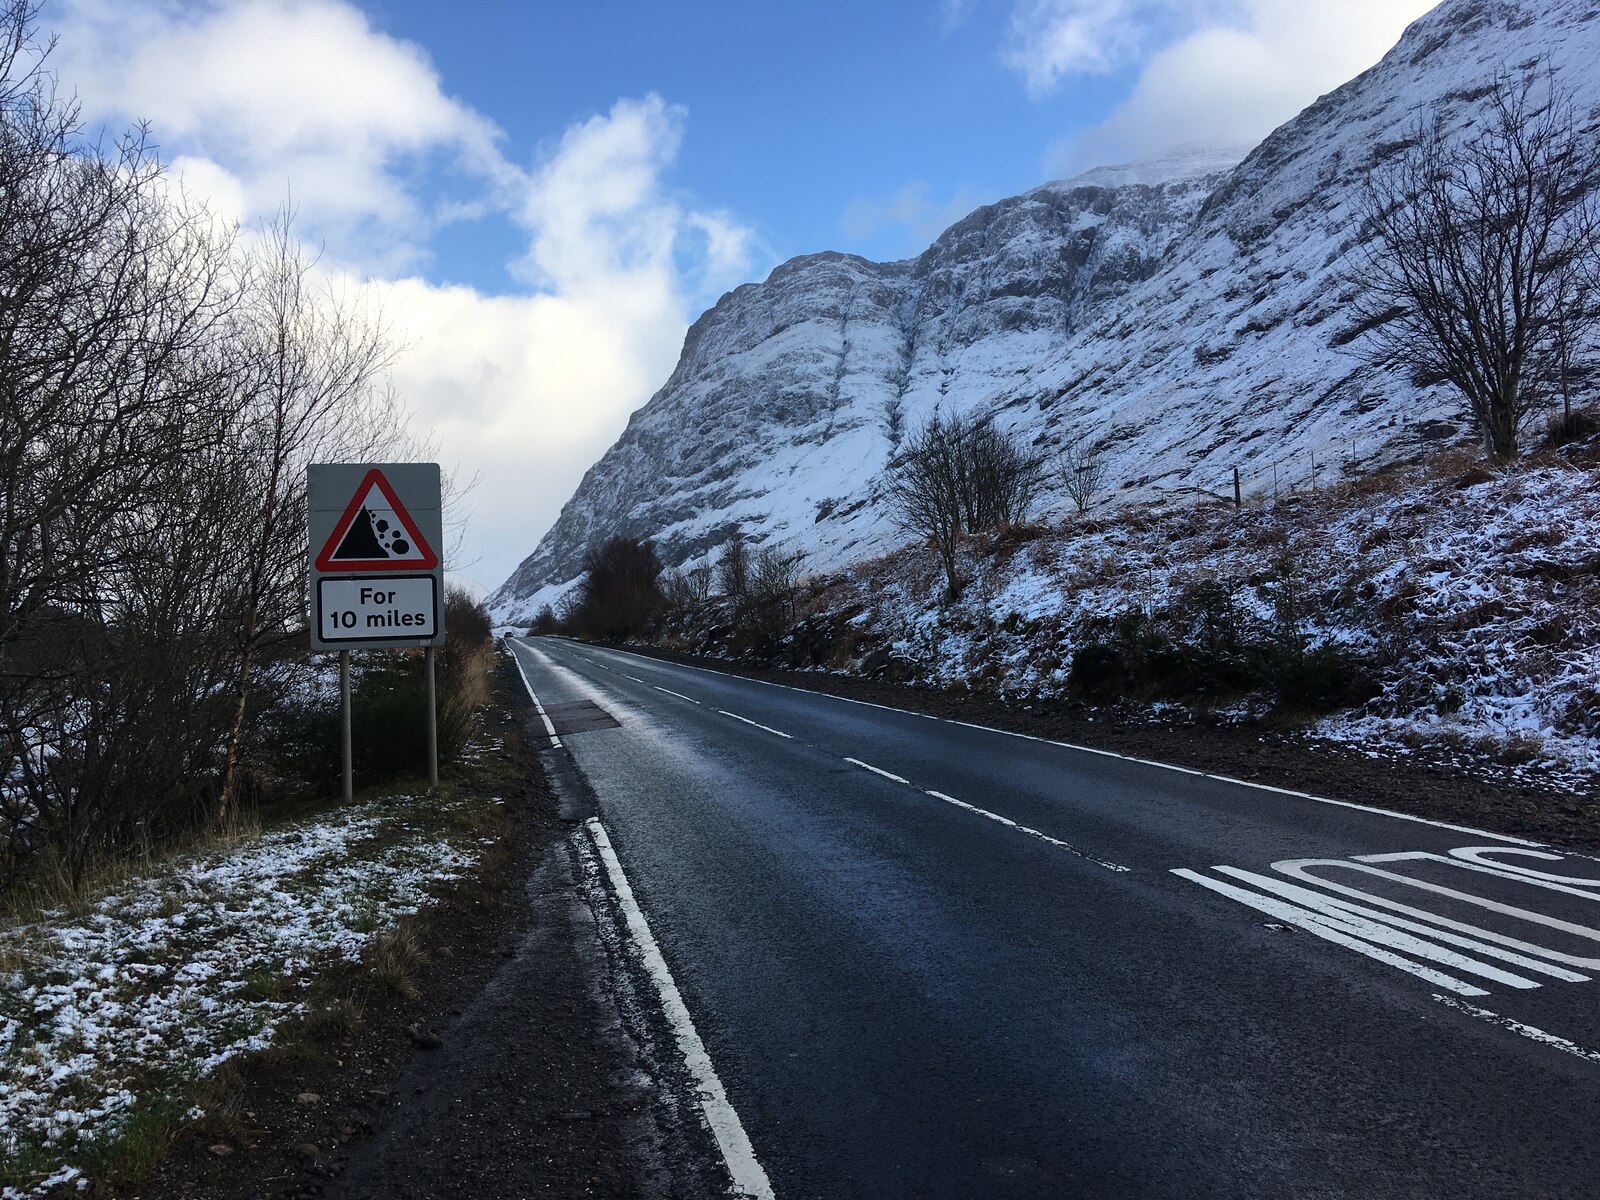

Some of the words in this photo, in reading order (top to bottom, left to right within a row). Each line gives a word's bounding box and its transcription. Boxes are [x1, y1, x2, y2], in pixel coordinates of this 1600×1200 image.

[360, 587, 396, 605] For
[330, 611, 357, 629] 10
[366, 609, 426, 628] miles
